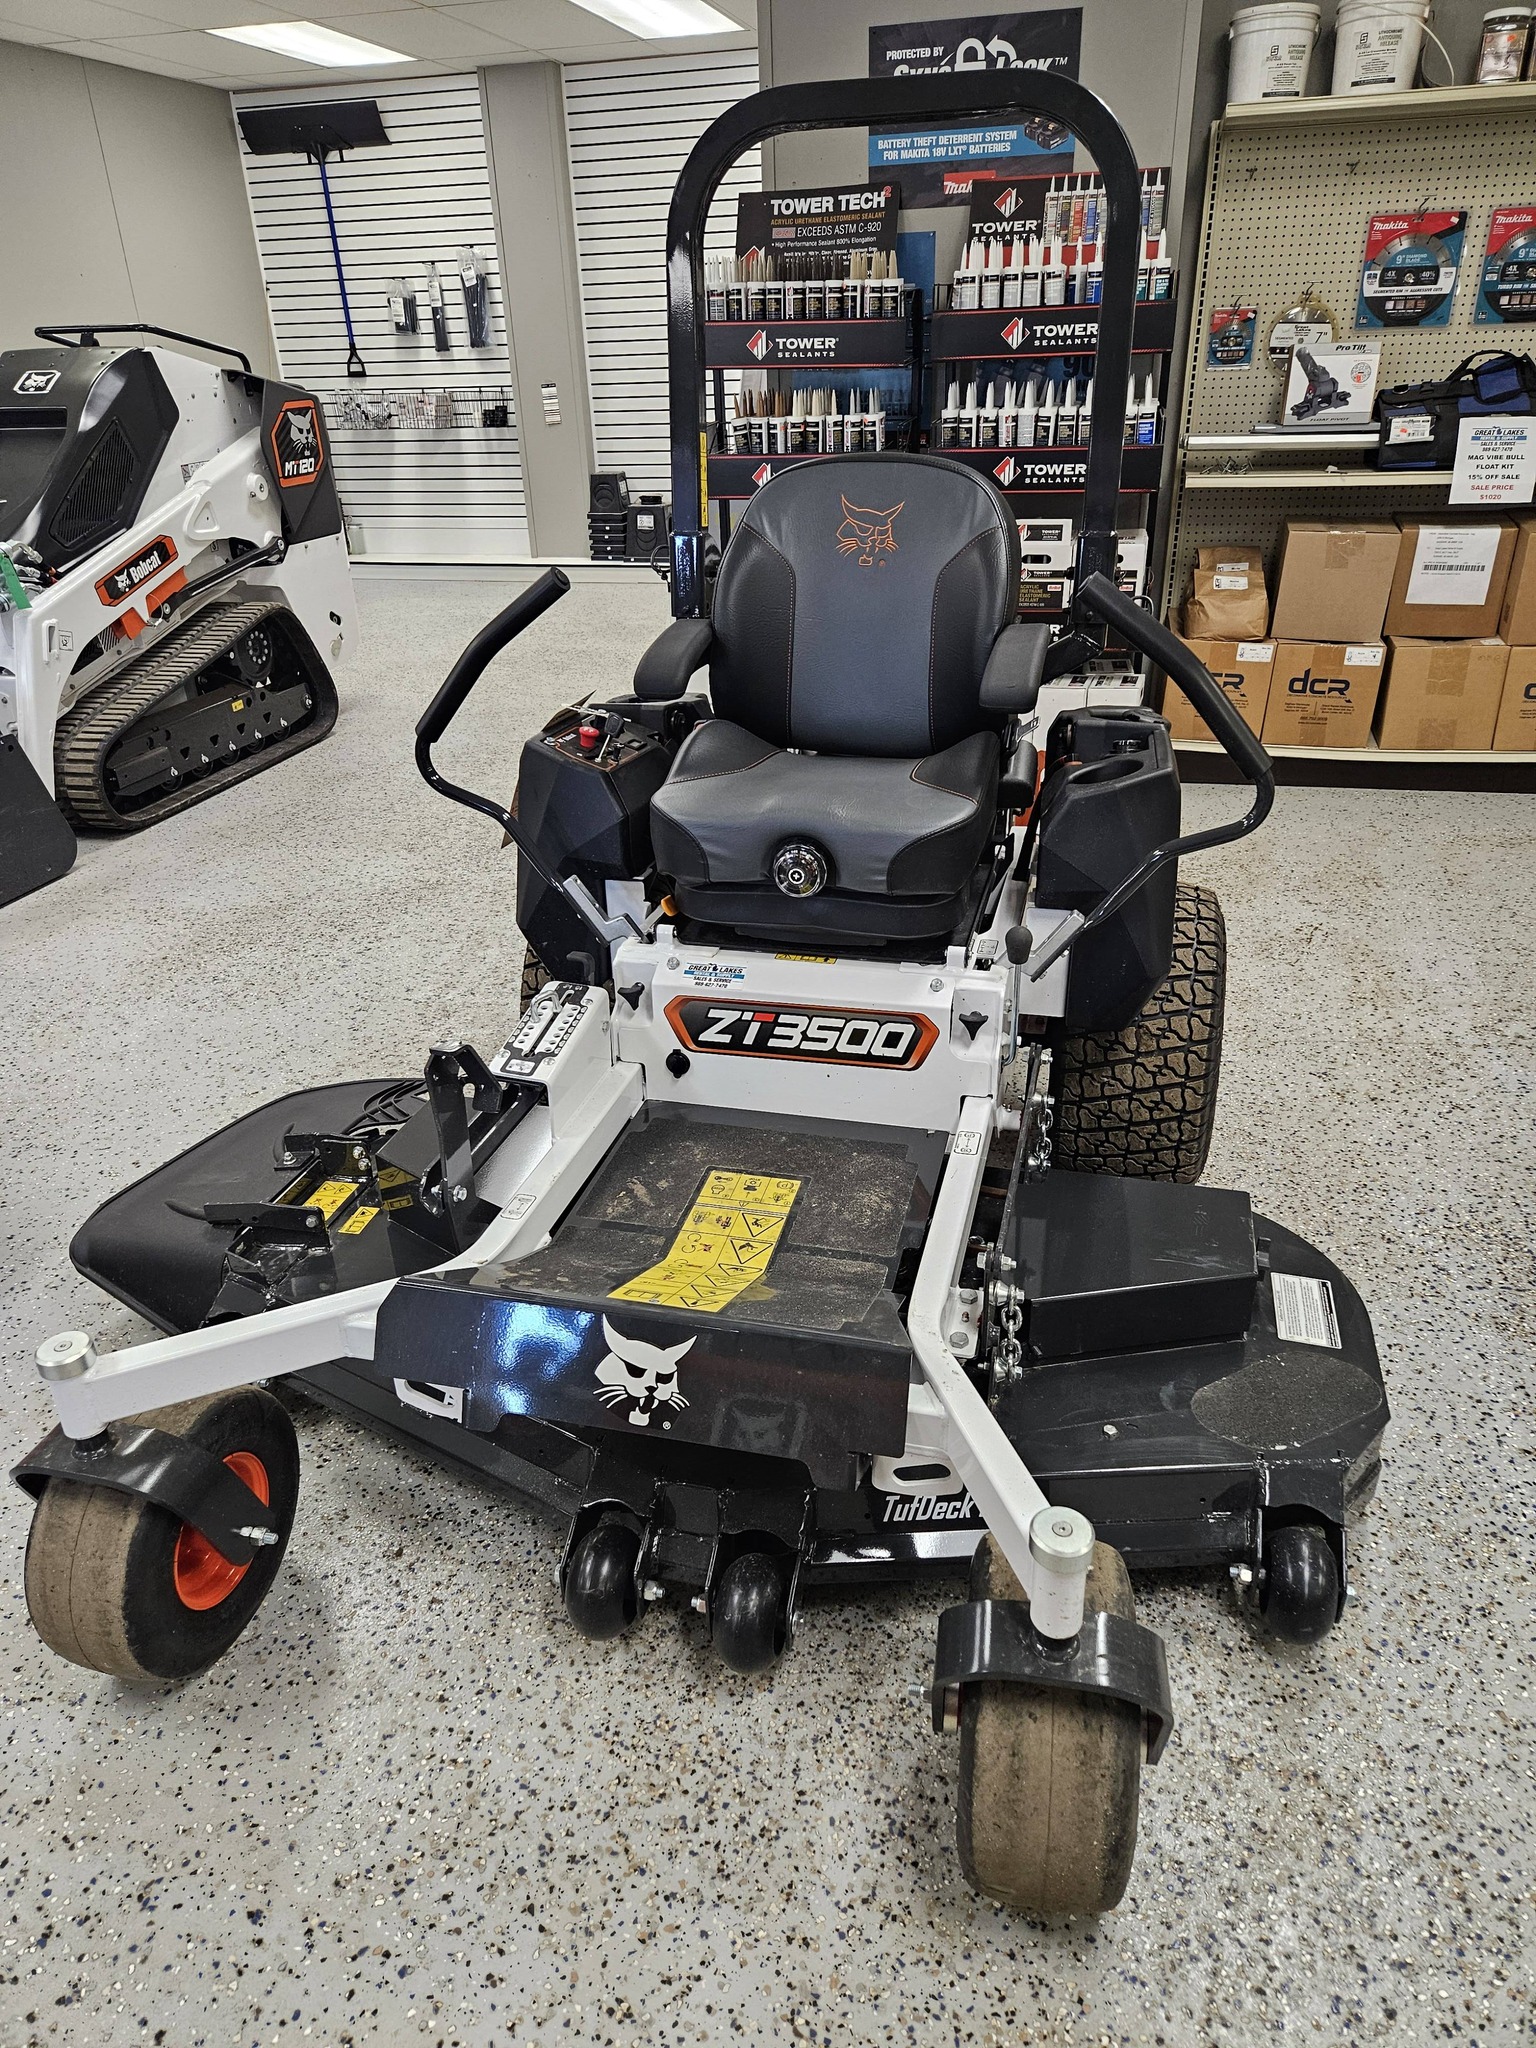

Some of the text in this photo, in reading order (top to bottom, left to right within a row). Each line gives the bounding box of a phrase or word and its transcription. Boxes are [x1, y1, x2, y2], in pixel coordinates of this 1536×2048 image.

[886, 46, 944, 61] PROTECTED BY
[878, 130, 1017, 150] BATTERY THEFT DETERRENT SYSTEM
[884, 150, 898, 160] FOR
[900, 148, 930, 159] MAKITA
[932, 147, 946, 157] 18V
[969, 142, 1011, 154] BATTERIES
[770, 196, 834, 215] TOWER
[770, 212, 885, 226] ACRYLIC URETHANE ELASTOMERIC SEALANT
[1373, 220, 1409, 230] Makita
[1495, 214, 1533, 224] Makita
[797, 225, 833, 237] EXCEEDS
[834, 224, 857, 235] ASTM
[858, 221, 882, 233] C-920
[972, 220, 1038, 234] TOWER
[852, 236, 877, 244] Elongation
[1033, 323, 1098, 337] TOWER
[775, 338, 836, 349] TOWER
[1034, 337, 1097, 347] SEALANTS
[1315, 332, 1328, 343] 7"
[1352, 344, 1366, 352] Tilt
[1024, 464, 1087, 476] TOWER
[130, 550, 162, 584] Bobcat
[698, 1008, 916, 1058] ZT3500
[883, 1492, 975, 1522] TufDeck
